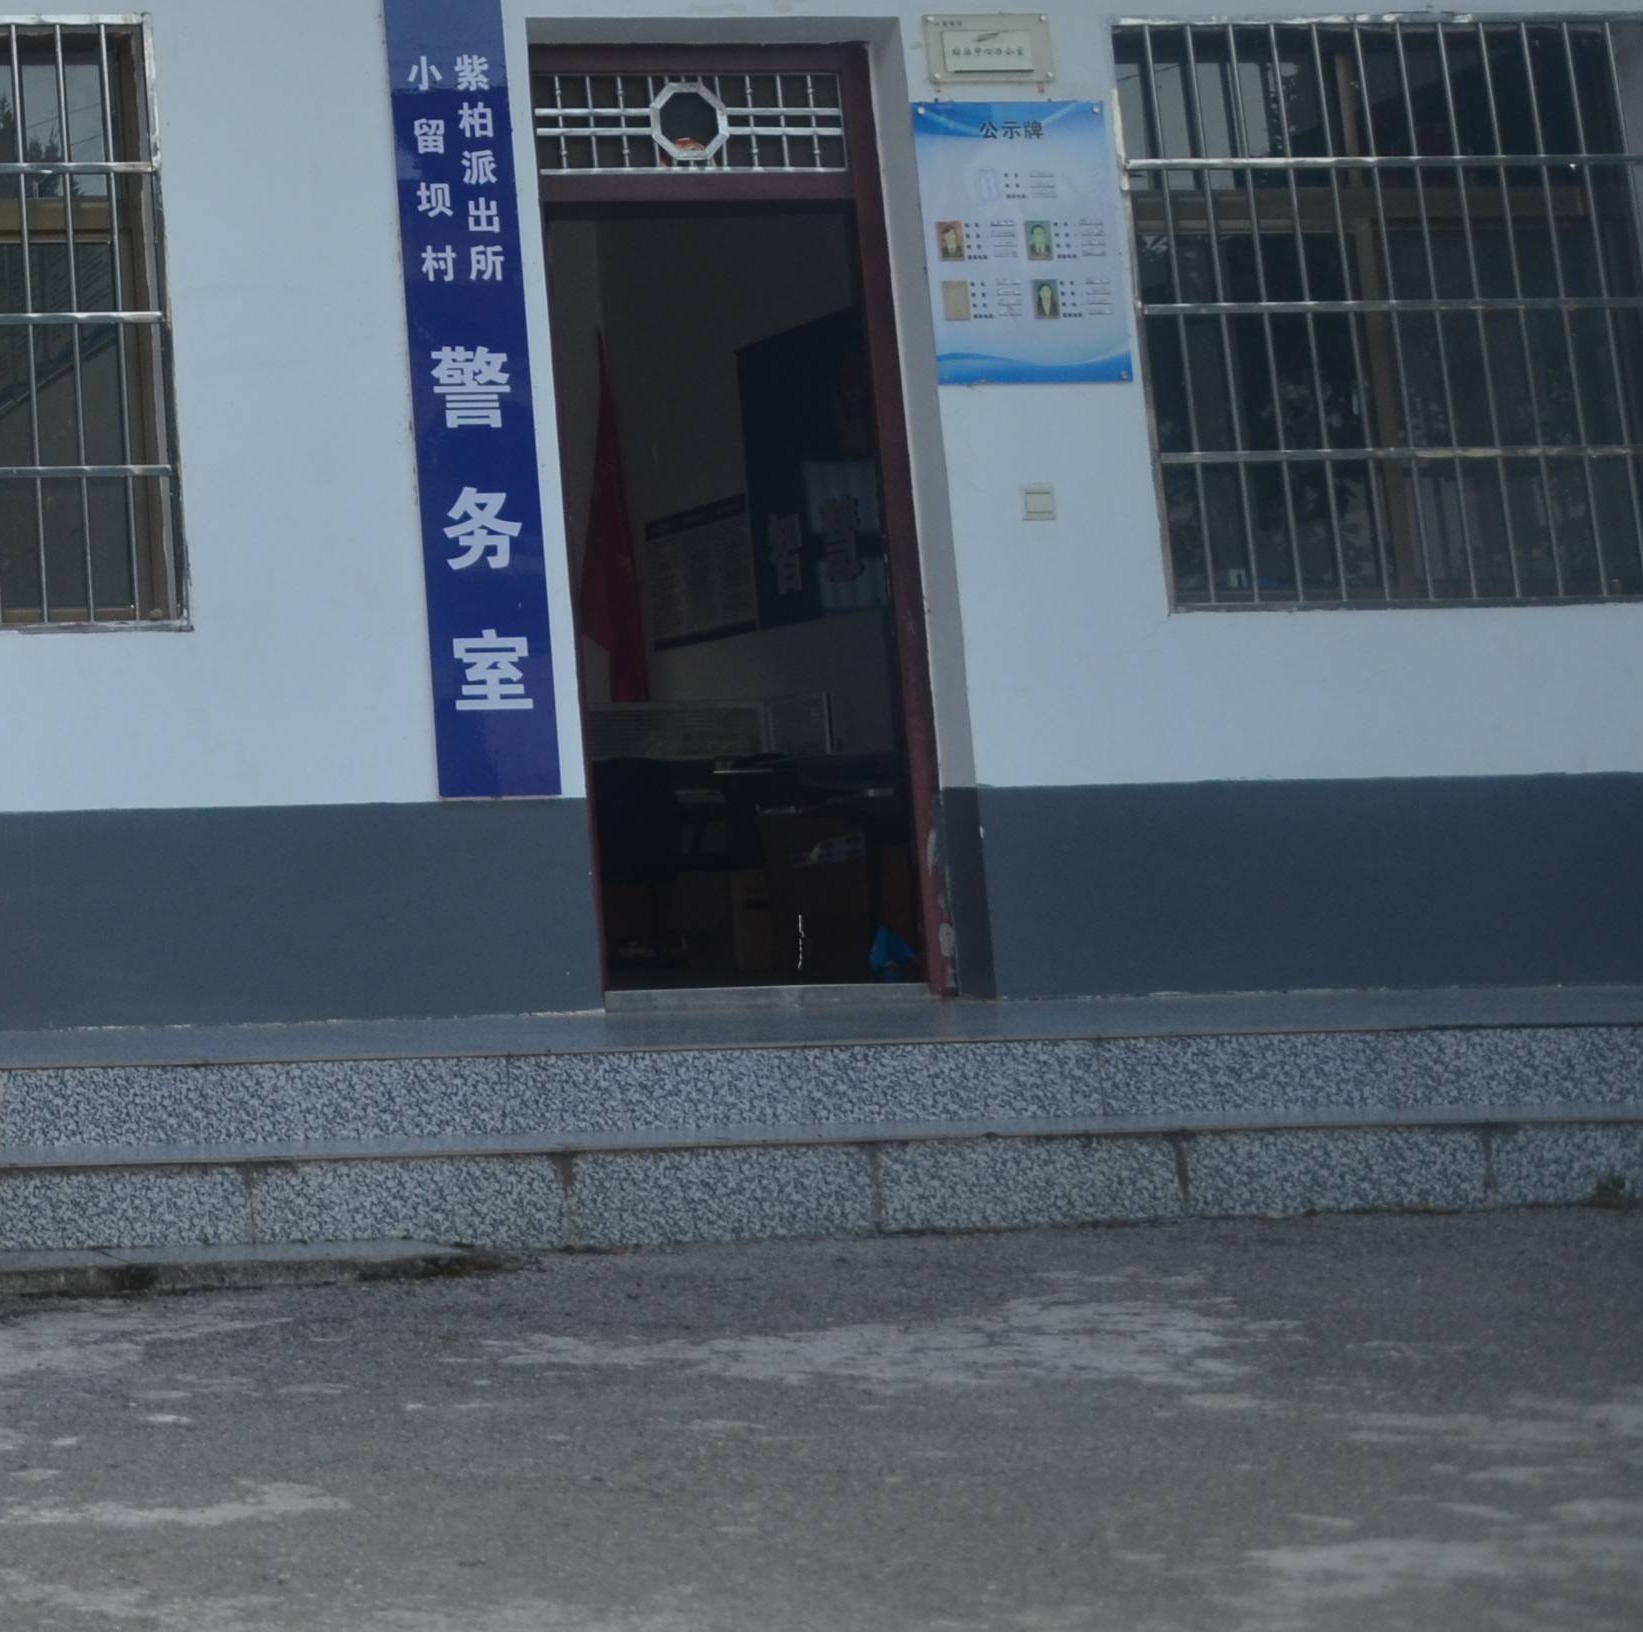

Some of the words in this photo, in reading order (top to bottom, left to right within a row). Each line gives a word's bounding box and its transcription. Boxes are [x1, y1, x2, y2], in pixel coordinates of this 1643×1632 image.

[407, 54, 458, 283] 小留坝村
[453, 54, 505, 282] 紫柏派出所
[979, 120, 1044, 140] 公示牌
[430, 345, 535, 713] 警务室
